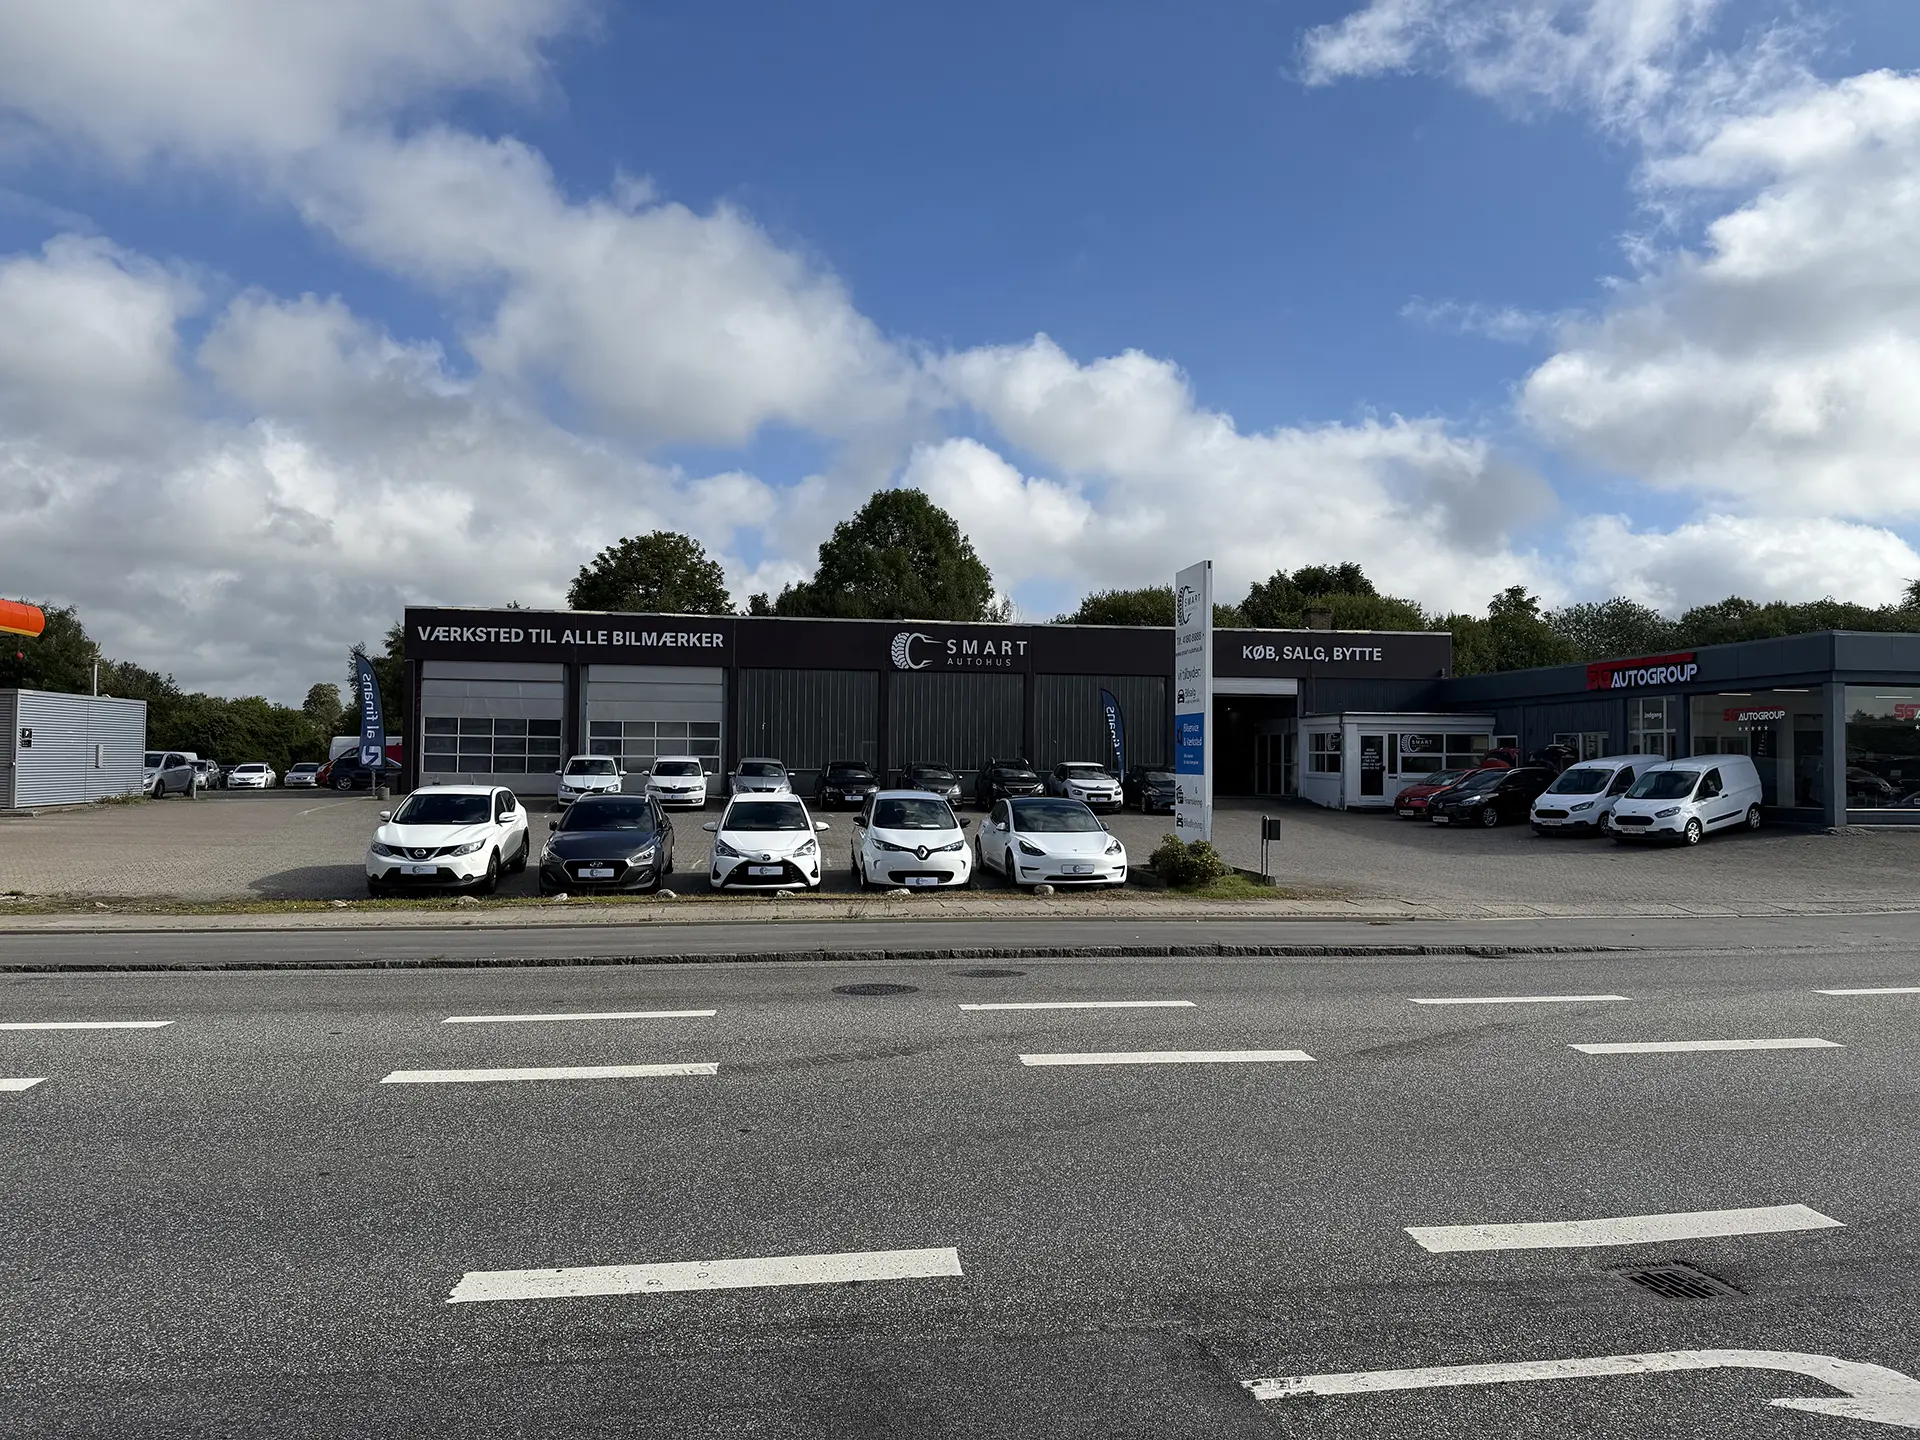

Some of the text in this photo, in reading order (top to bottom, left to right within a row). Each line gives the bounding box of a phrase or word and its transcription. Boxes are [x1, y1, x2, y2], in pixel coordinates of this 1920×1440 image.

[1184, 593, 1201, 607] SMART
[417, 626, 724, 648] VÆRKSTED TIL ALLE BILMÆRKER
[946, 639, 1028, 656] SMART
[1242, 645, 1382, 662] KØB, SALG, BYTTE
[946, 657, 1012, 667] AUTOHUS
[1611, 663, 1698, 689] AUTOGROUP
[1644, 711, 1662, 720] Indgang
[1738, 710, 1785, 722] AUTOGROUP
